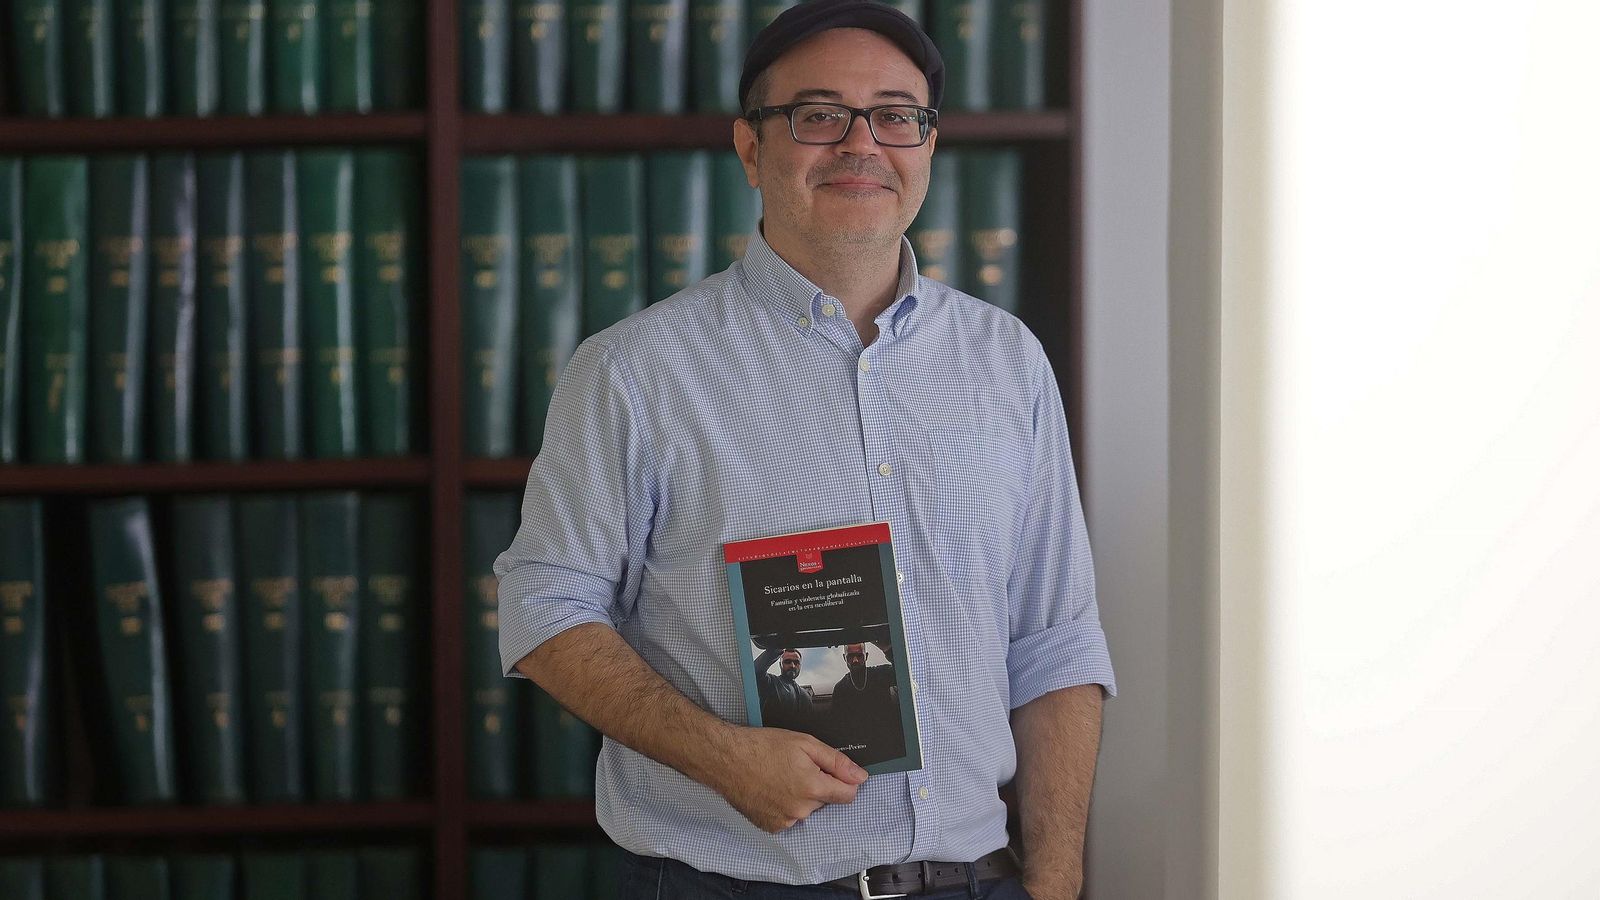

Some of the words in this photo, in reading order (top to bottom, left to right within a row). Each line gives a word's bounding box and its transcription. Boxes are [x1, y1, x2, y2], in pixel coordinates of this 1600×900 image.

[764, 583, 800, 595] Sicarios
[801, 582, 813, 590] en
[815, 579, 824, 588] la
[826, 573, 862, 589] pantalla
[770, 598, 793, 607] Familia
[799, 594, 826, 603] violencia
[826, 590, 860, 601] globalizada
[814, 599, 844, 608] neoliberal
